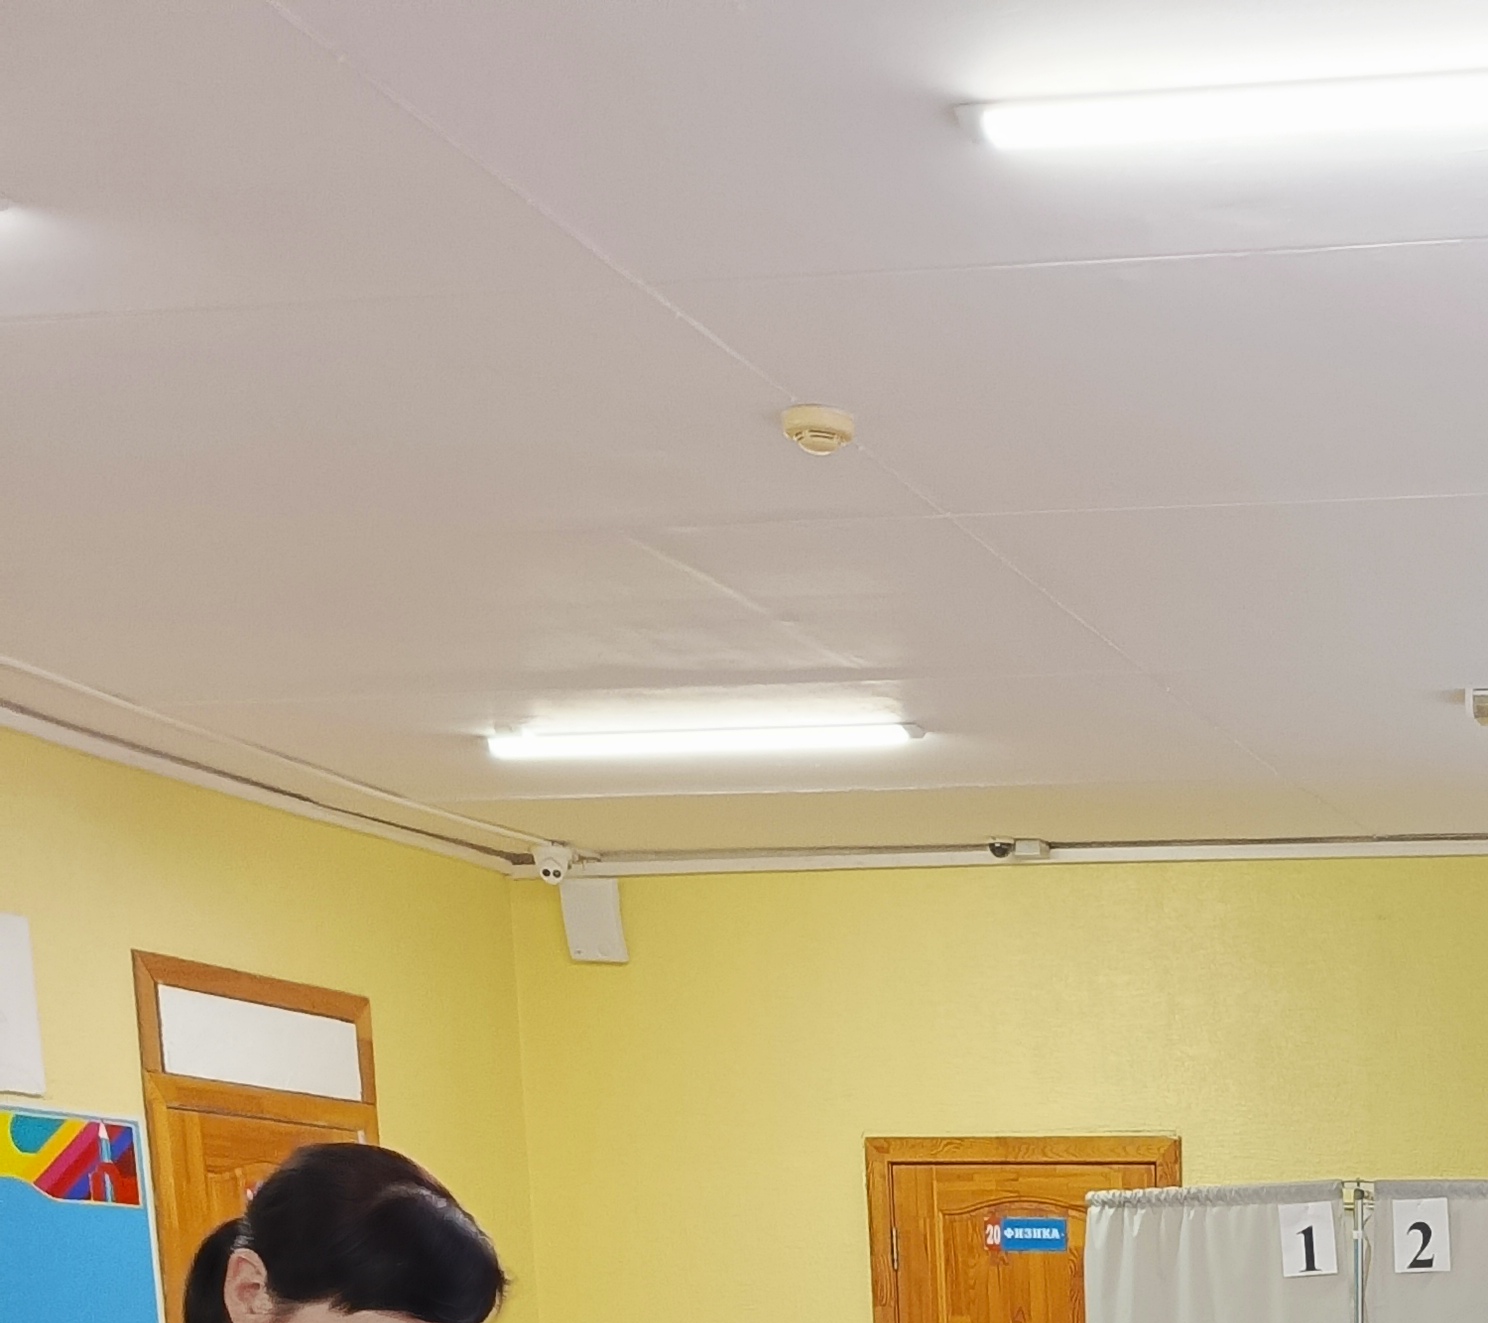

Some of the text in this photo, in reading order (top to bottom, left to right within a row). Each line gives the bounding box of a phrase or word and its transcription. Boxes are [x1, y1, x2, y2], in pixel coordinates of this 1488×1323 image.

[986, 1224, 1061, 1245] 20 ФИЗИКА
[1296, 1225, 1322, 1272] 1
[1406, 1221, 1435, 1269] 2
